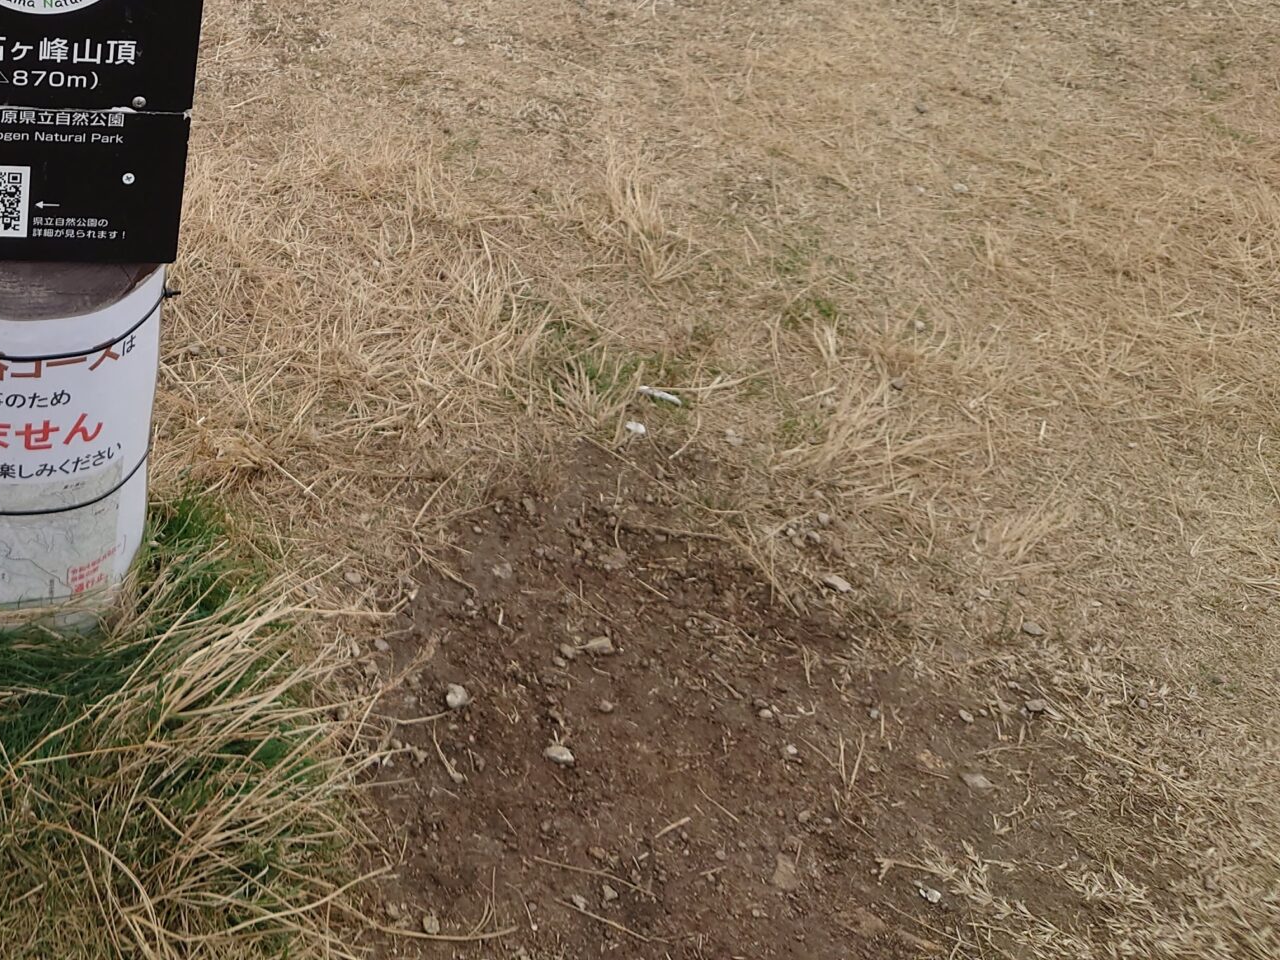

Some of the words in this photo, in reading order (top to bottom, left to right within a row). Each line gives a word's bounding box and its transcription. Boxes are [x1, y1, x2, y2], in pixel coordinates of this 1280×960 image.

[35, 131, 86, 143] Natural
[91, 133, 124, 144] Park
[32, 217, 109, 227] 県立自然公園の
